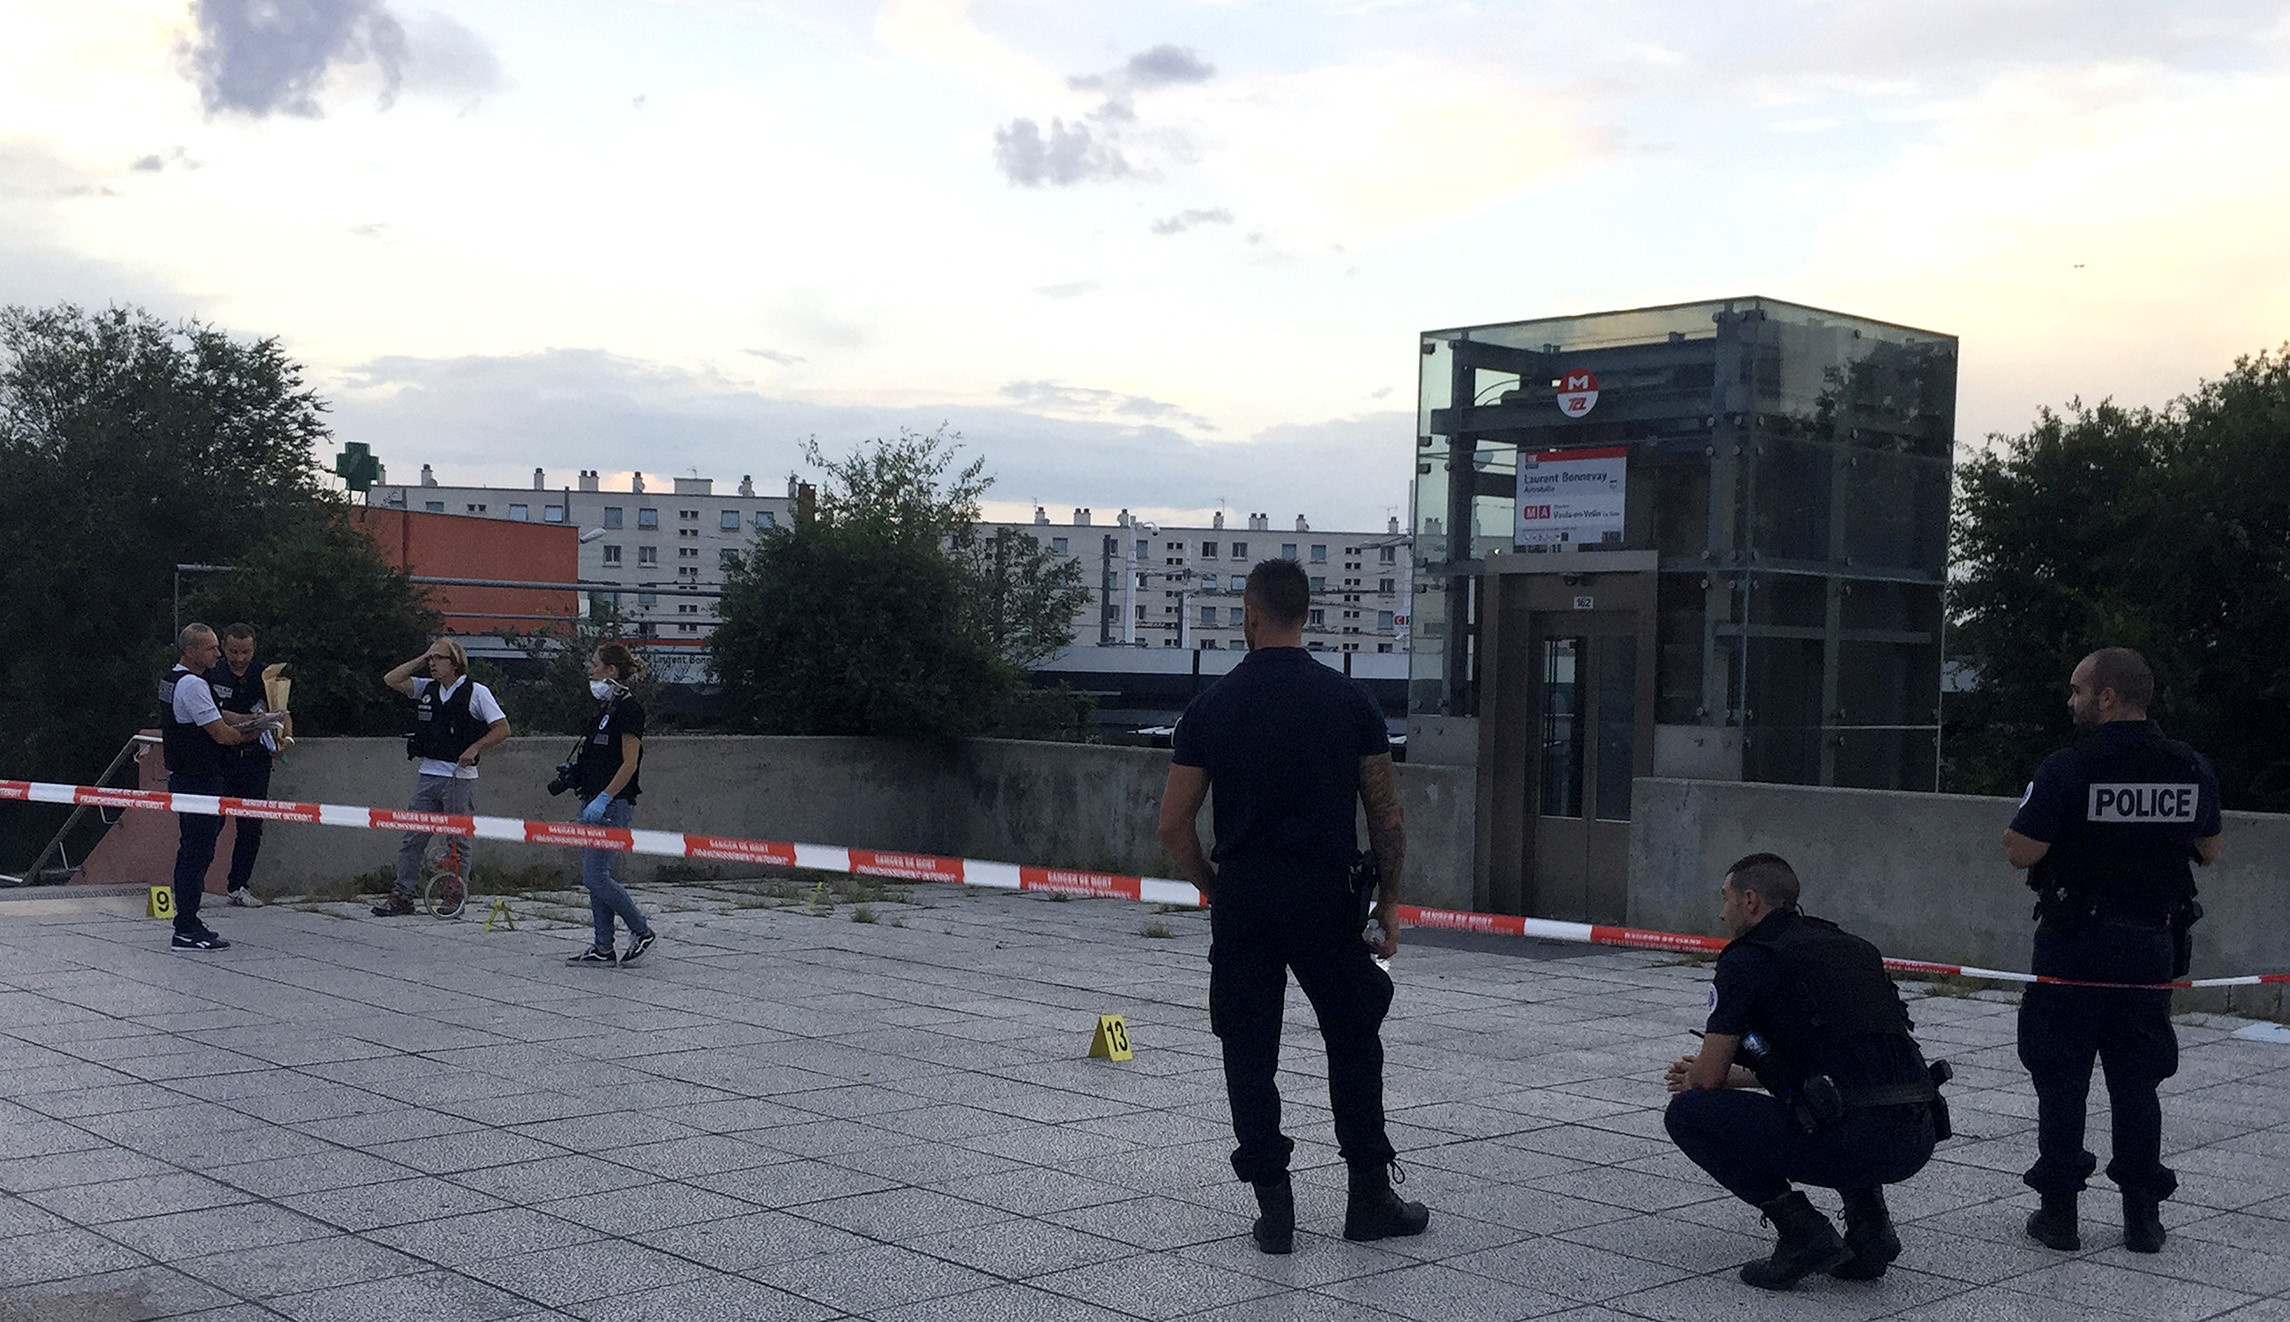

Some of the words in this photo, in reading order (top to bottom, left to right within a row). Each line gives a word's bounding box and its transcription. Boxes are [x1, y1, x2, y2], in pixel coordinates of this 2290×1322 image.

[1568, 375, 1589, 390] M
[1524, 473, 1559, 485] Laurent
[1562, 471, 1607, 484] Bonnevay
[1576, 598, 1591, 608] 162
[2095, 788, 2192, 817] POLICE
[156, 890, 170, 912] 9
[1106, 1020, 1128, 1052] 13
